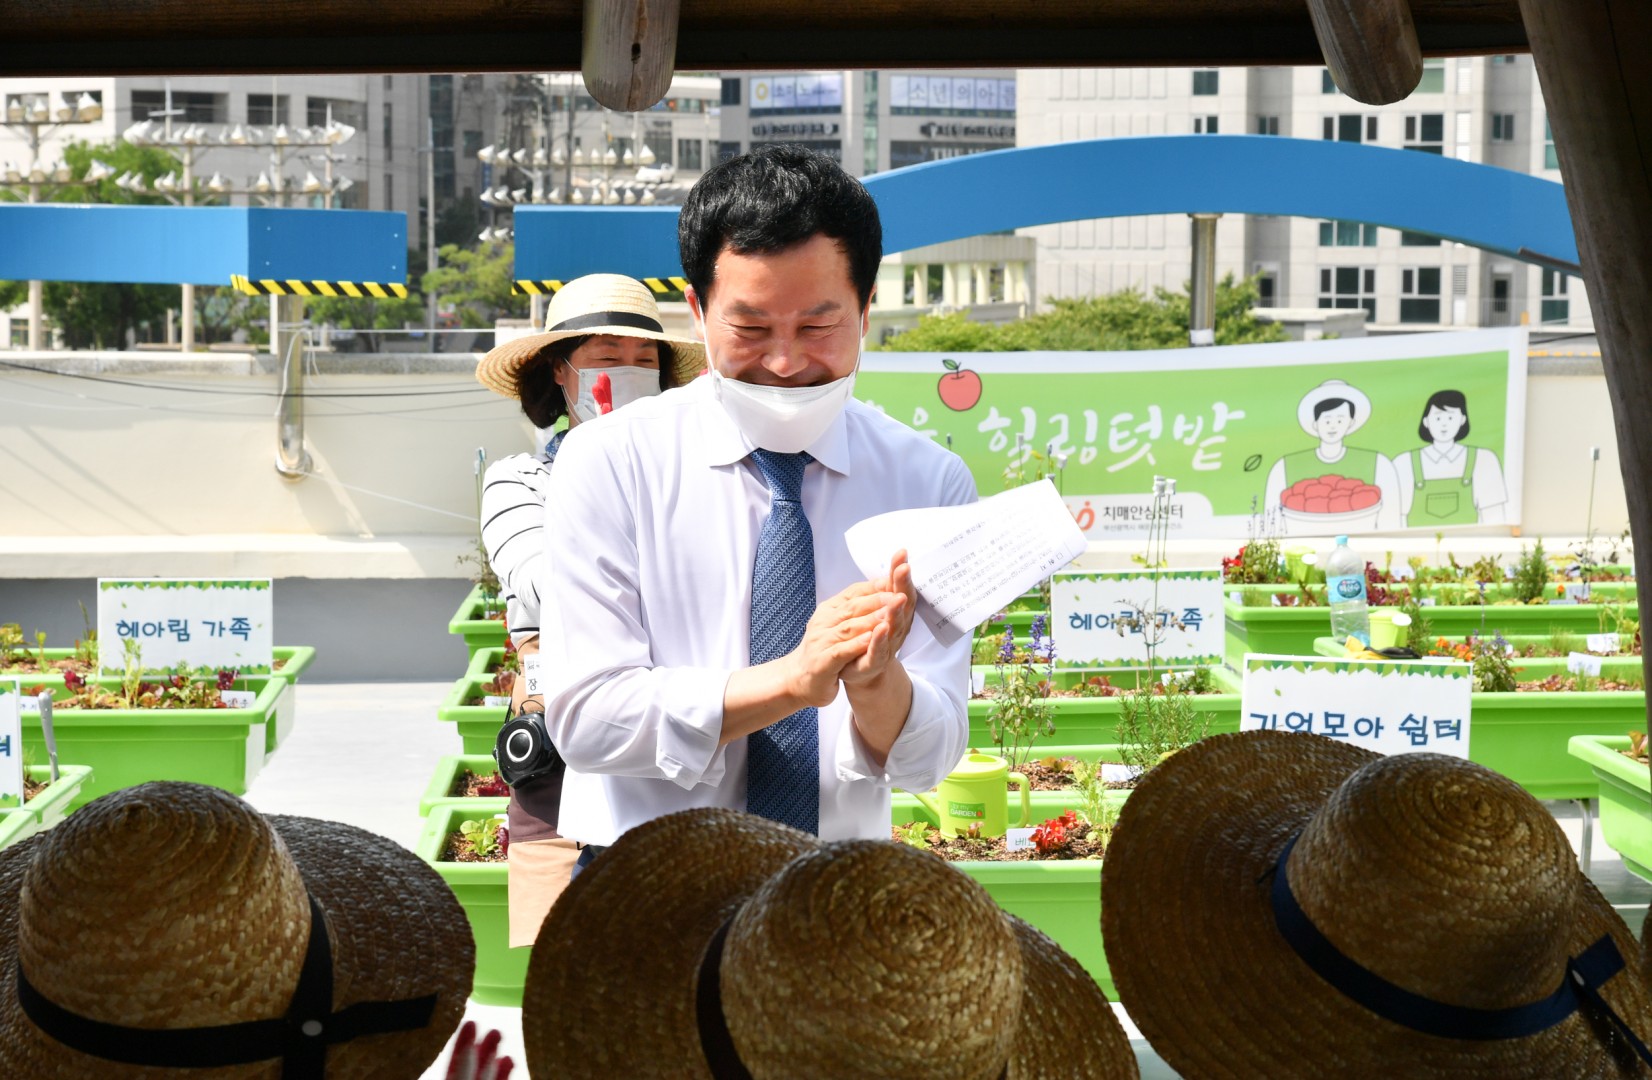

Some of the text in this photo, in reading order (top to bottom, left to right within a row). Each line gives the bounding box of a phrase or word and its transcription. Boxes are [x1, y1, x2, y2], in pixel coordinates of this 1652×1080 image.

[1103, 504, 1184, 521] 치매안심센터
[115, 616, 252, 643] 헤아림 가족
[1068, 607, 1203, 634] 헤아림 가족
[1398, 712, 1463, 747] 쉼터
[950, 808, 977, 817] GARDEN
